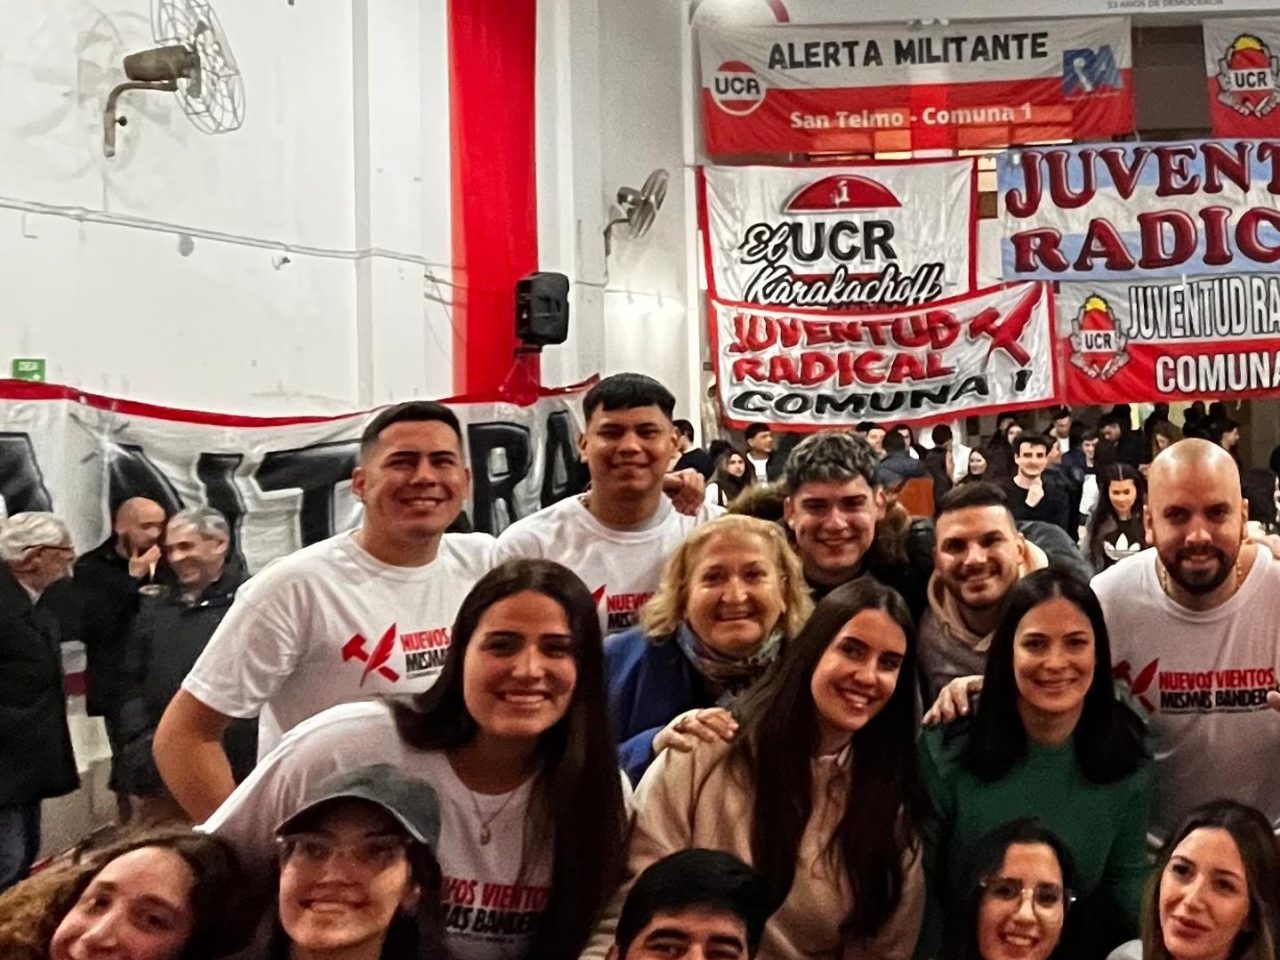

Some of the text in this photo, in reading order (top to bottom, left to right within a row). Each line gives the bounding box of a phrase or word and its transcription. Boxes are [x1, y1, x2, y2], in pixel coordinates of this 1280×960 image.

[768, 31, 1050, 70] ALERTA MILITANTE
[714, 74, 762, 96] UCR
[1234, 71, 1267, 89] UCR
[790, 111, 831, 129] San
[834, 109, 904, 128] Telmo
[922, 105, 1015, 126] Comuna
[1018, 103, 1033, 120] 1
[791, 219, 897, 262] UCR
[744, 262, 945, 307] Karakachoff
[1127, 276, 1245, 339] JUVENTUD
[729, 309, 961, 353] JUVENTUD
[1084, 332, 1112, 350] UCR
[732, 350, 956, 387] RADICAL
[731, 374, 990, 415] COMUNA
[399, 627, 451, 652] NUEVOS
[1158, 667, 1276, 692] NUEVOS VIENTOS
[1159, 689, 1213, 709] MISMAS
